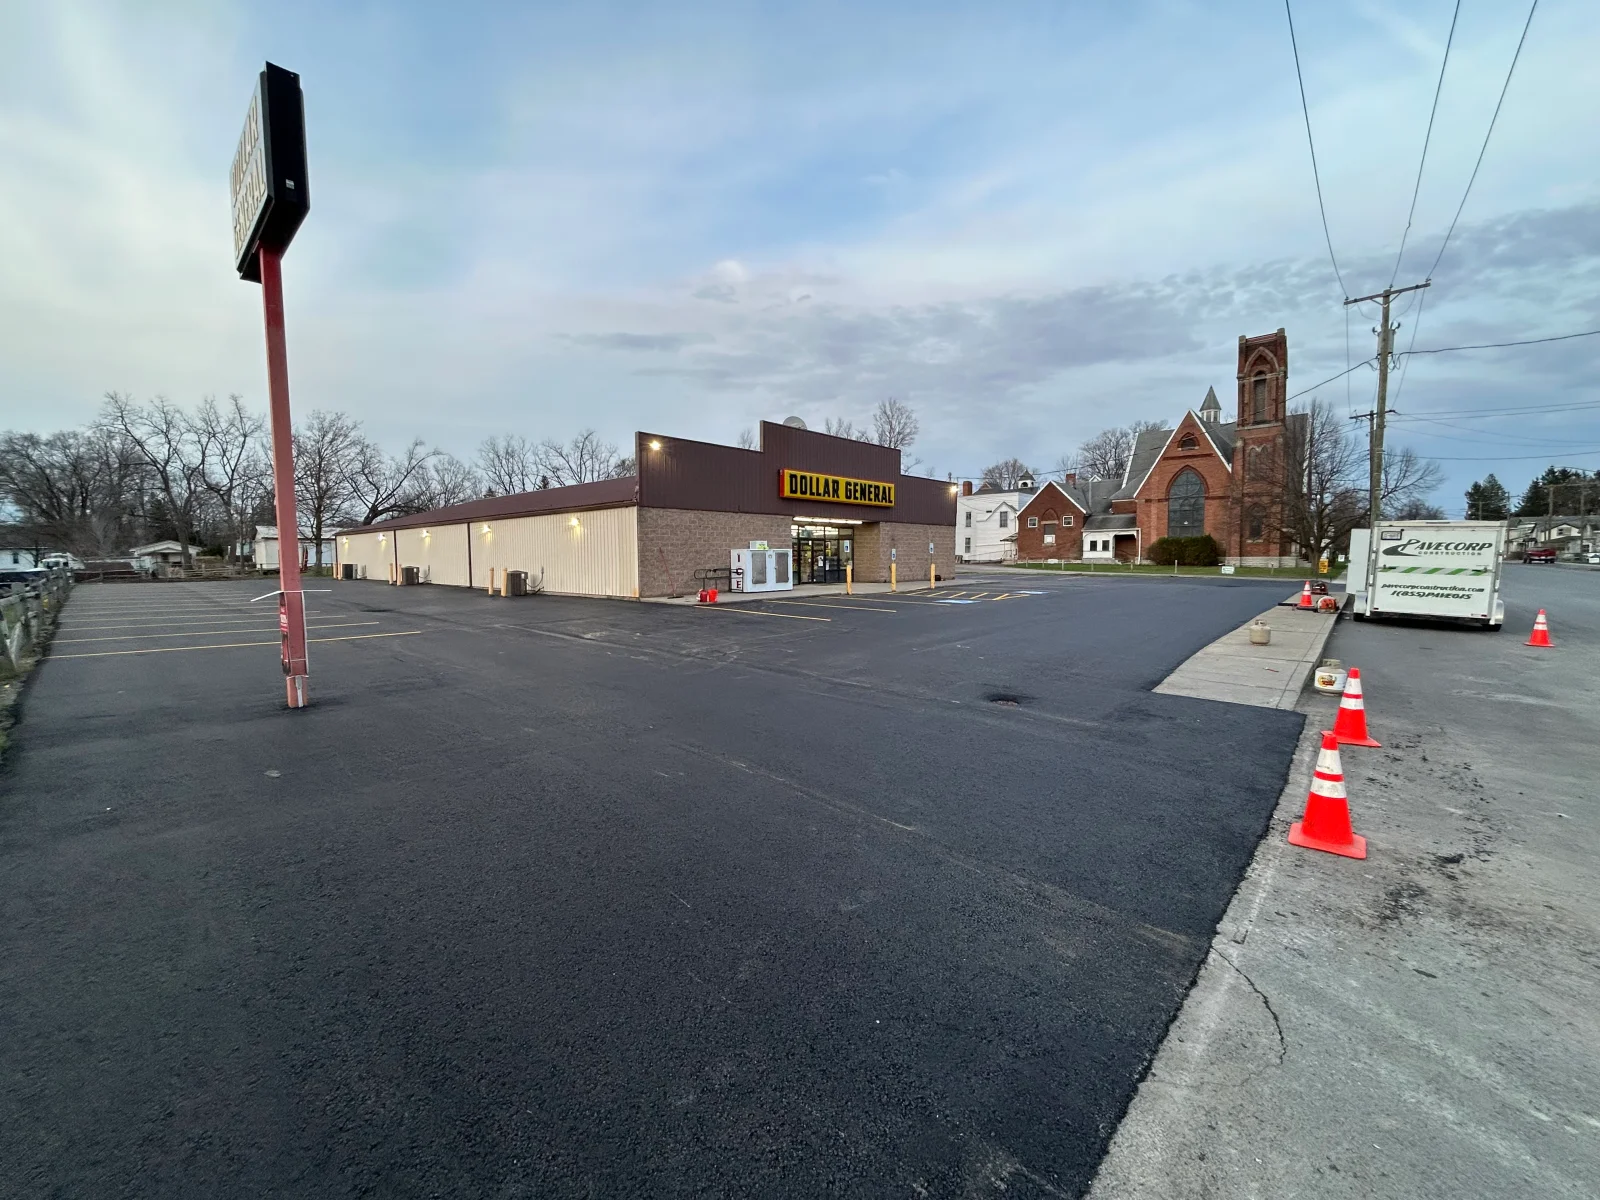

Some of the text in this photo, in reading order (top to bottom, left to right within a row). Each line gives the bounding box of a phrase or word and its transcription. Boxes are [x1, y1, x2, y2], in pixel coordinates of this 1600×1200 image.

[789, 473, 893, 504] DOLLAR GENERAL
[1394, 538, 1493, 552] PAVECORP
